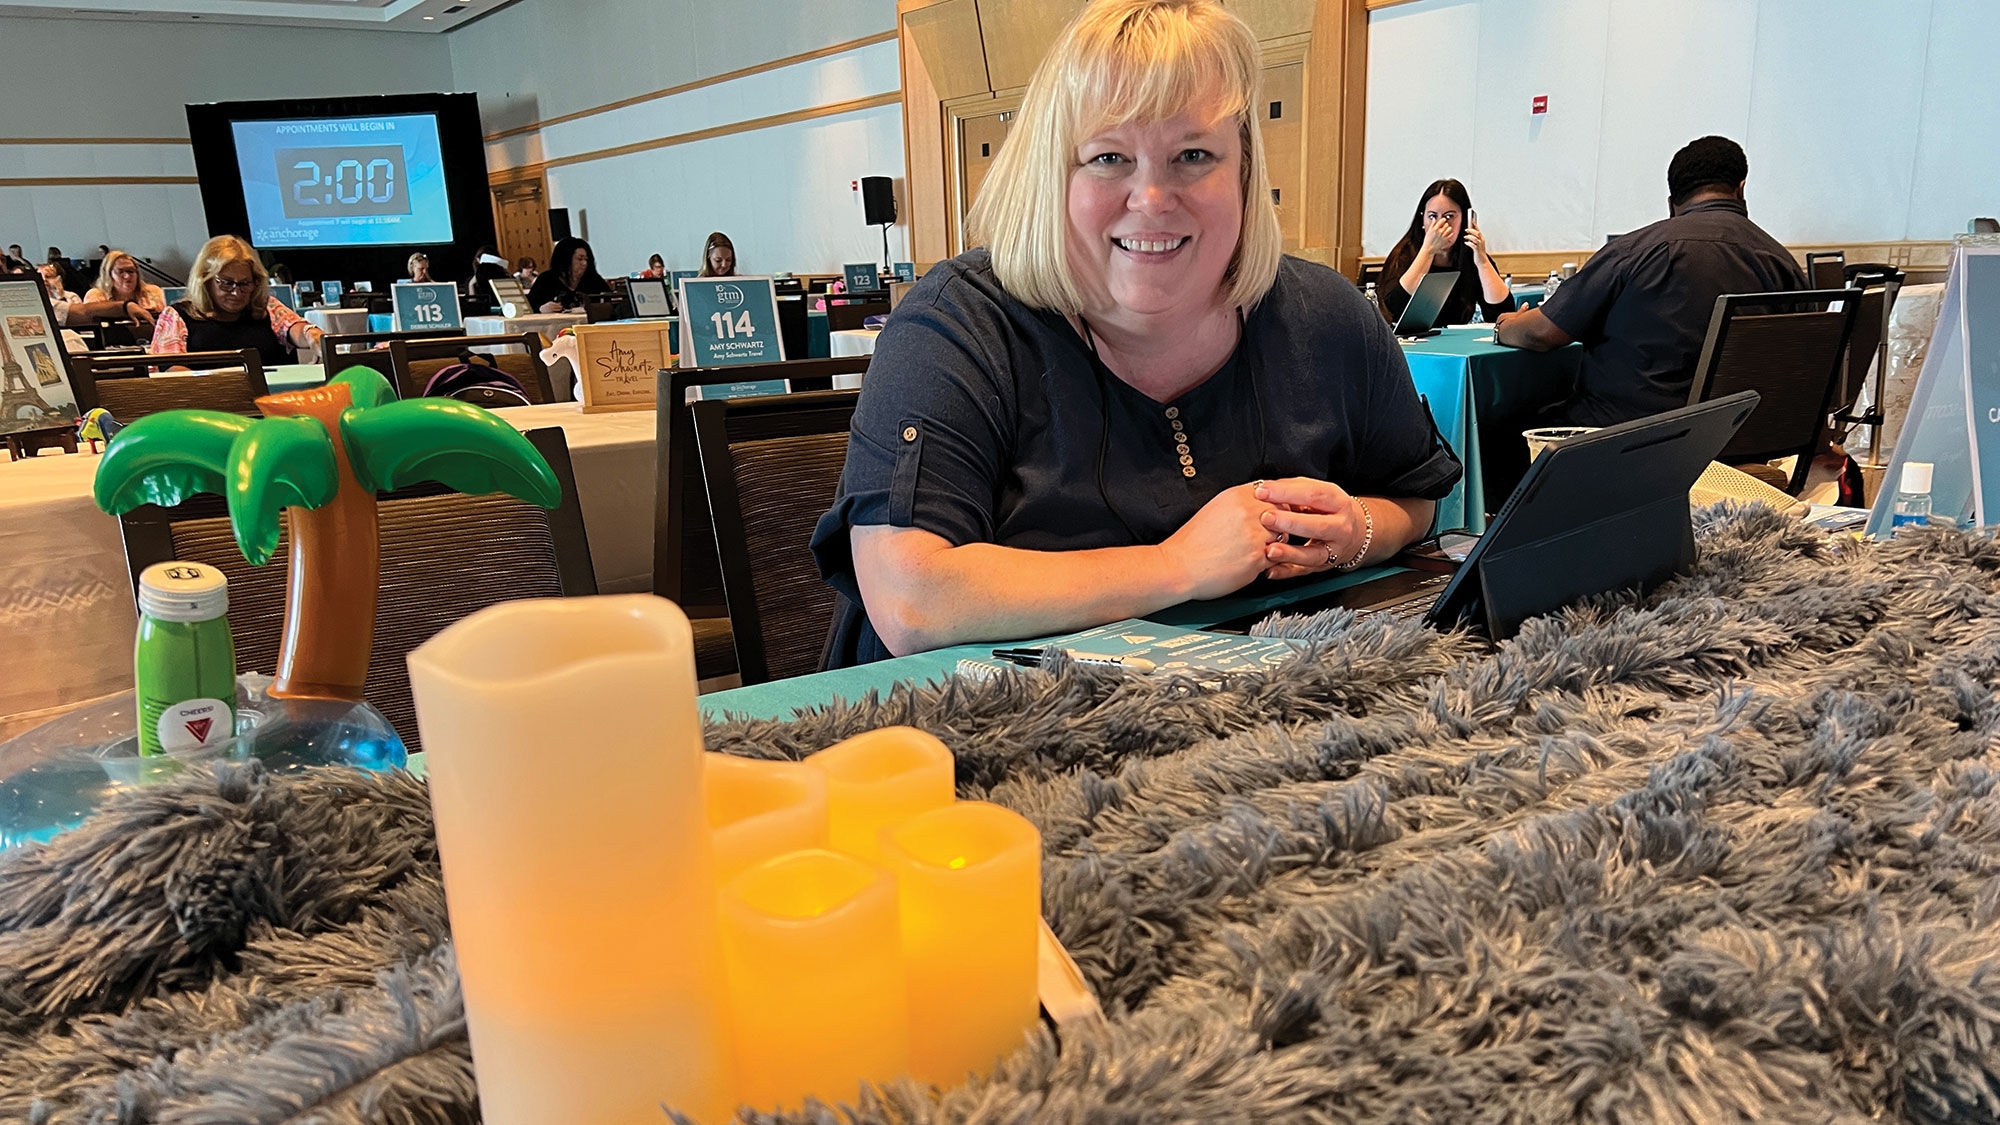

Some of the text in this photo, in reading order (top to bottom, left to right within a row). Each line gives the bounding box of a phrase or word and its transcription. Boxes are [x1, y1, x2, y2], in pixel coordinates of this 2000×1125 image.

[276, 121, 395, 134] APPOINTMENTS WILL BEGIN IN
[293, 158, 394, 206] 2:00
[269, 227, 319, 240] anchorage
[853, 275, 871, 286] 123
[717, 291, 740, 304] gtm
[414, 303, 443, 322] 113
[710, 310, 755, 339] 114
[609, 340, 636, 366] Amy
[709, 340, 764, 351] AMY SCHWARTZ
[596, 357, 655, 378] Schwartz
[1988, 407, 2000, 423] C
